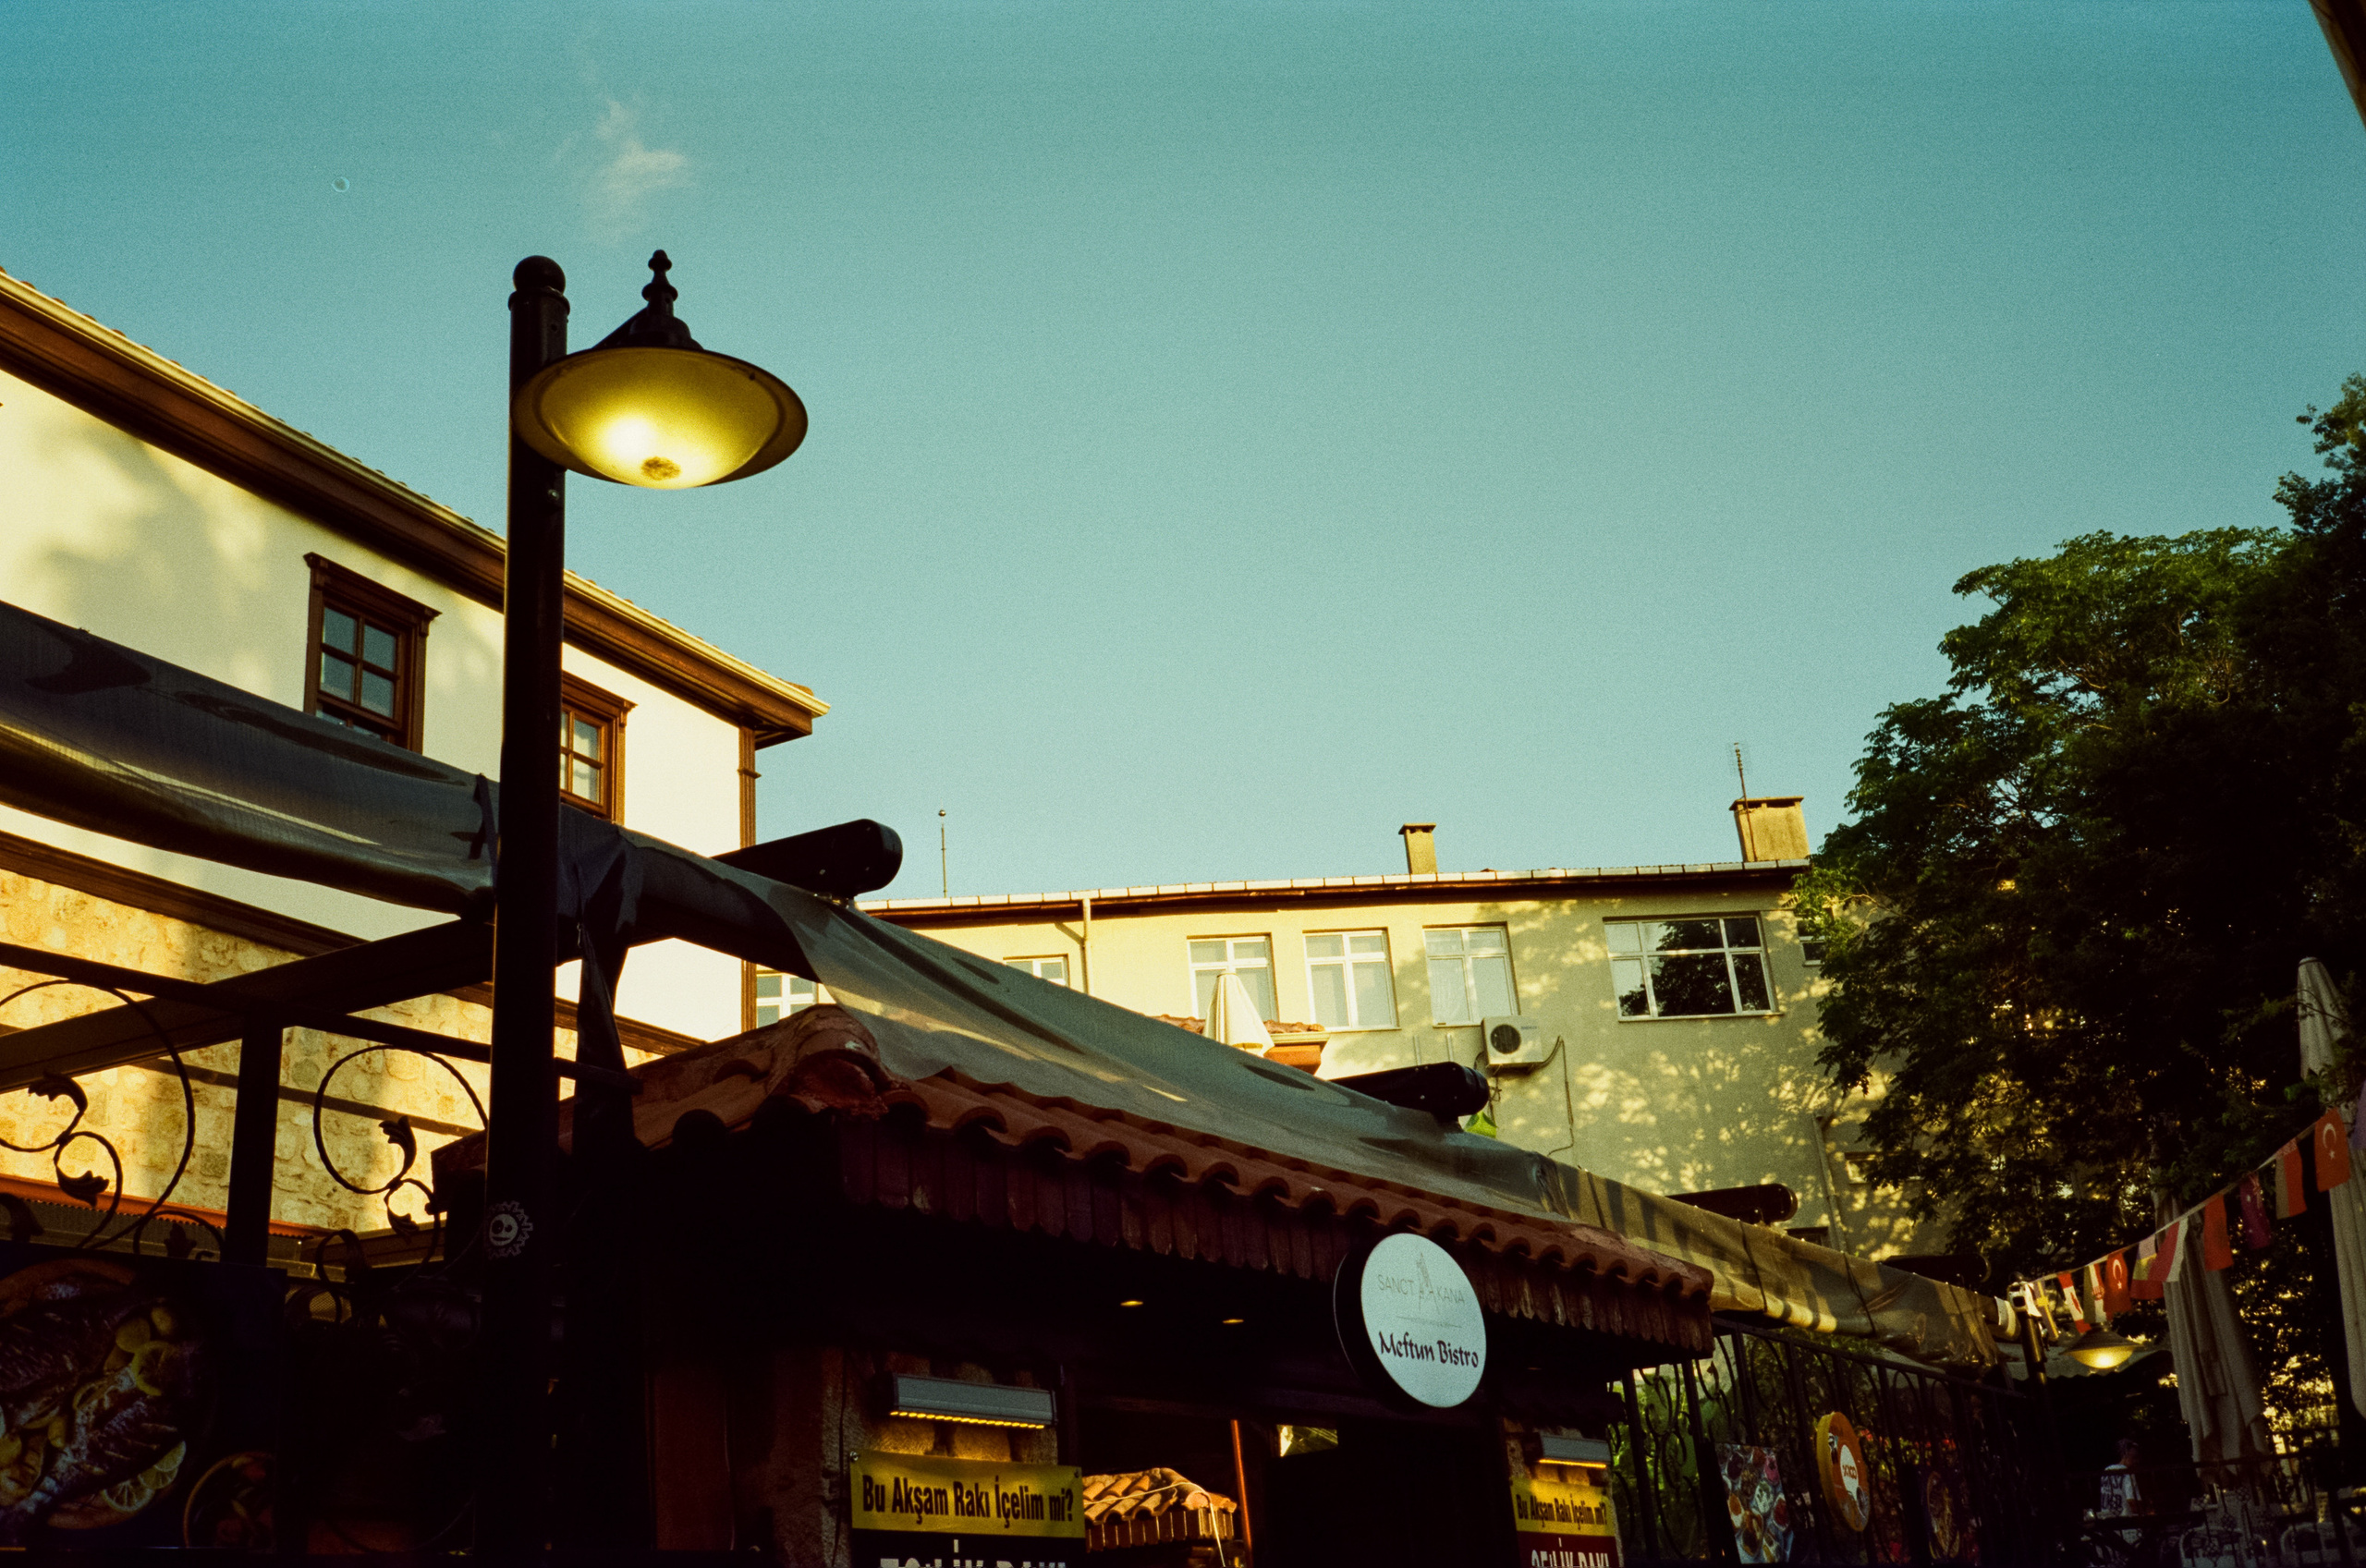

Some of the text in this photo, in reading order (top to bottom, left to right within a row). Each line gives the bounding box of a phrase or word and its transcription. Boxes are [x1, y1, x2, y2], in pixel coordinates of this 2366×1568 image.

[1378, 1331, 1479, 1368] Meftun Bistro
[862, 1475, 1073, 1528] Bu Akşam Rakı İçelim mi?
[1516, 1494, 1529, 1520] Bu
